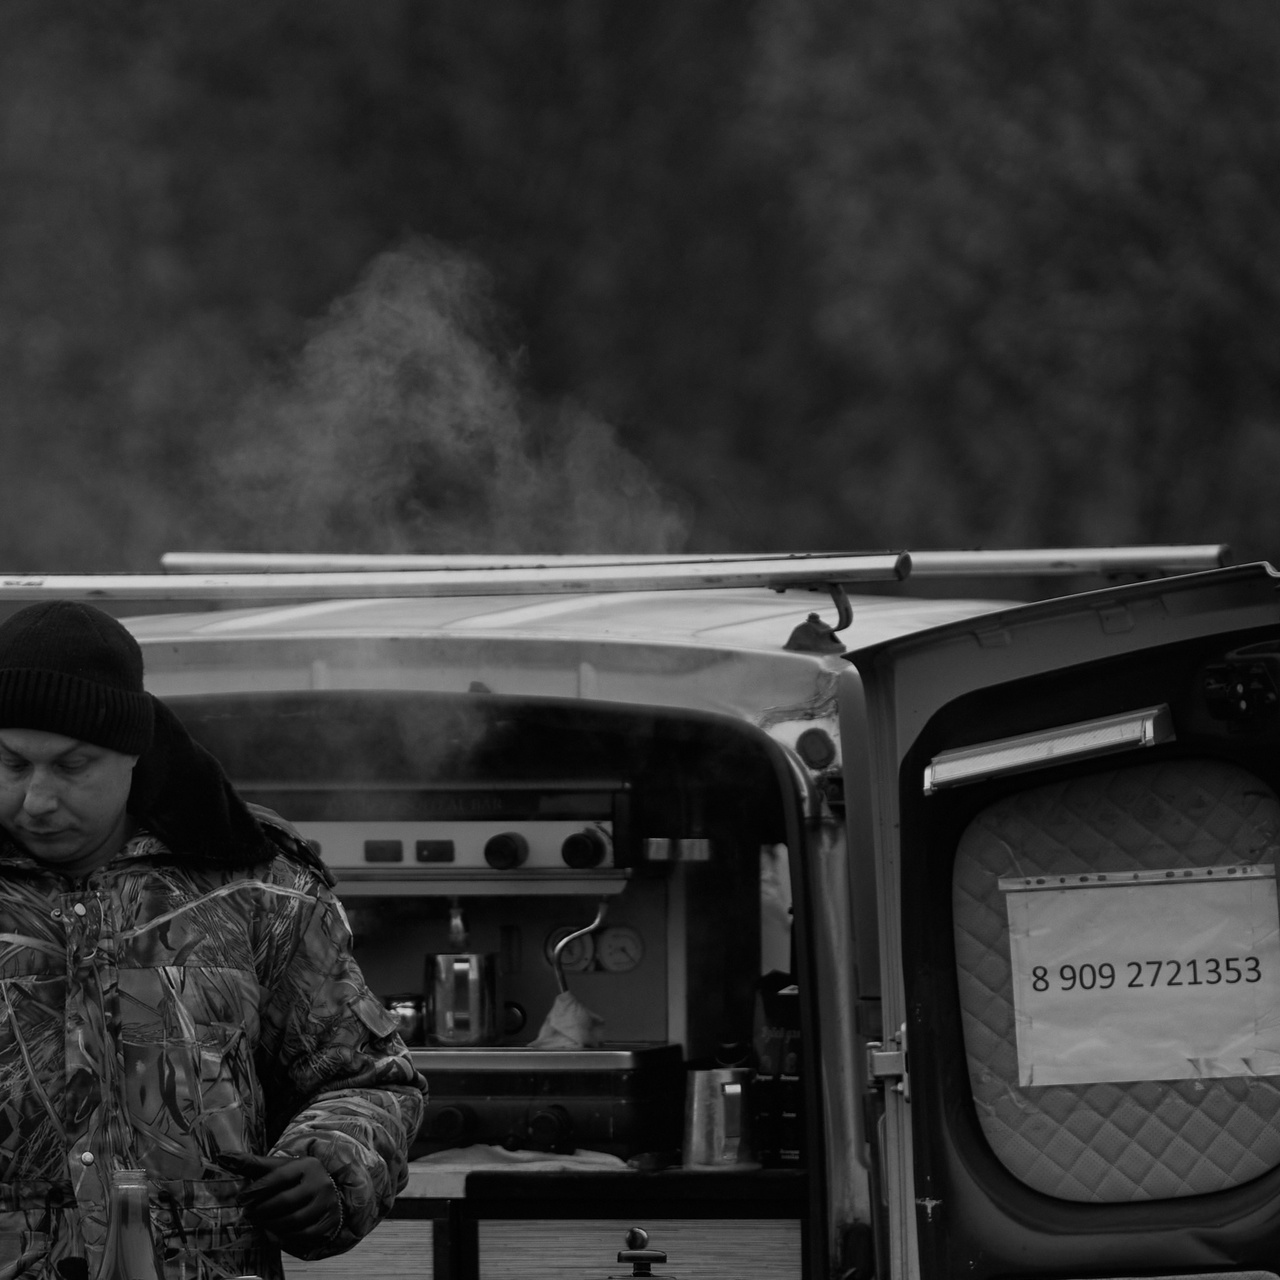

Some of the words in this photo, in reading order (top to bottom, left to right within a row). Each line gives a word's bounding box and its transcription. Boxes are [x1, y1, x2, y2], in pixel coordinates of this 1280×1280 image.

[1032, 966, 1049, 991] 8
[1060, 962, 1115, 991] 909
[1127, 957, 1261, 988] 2721353
